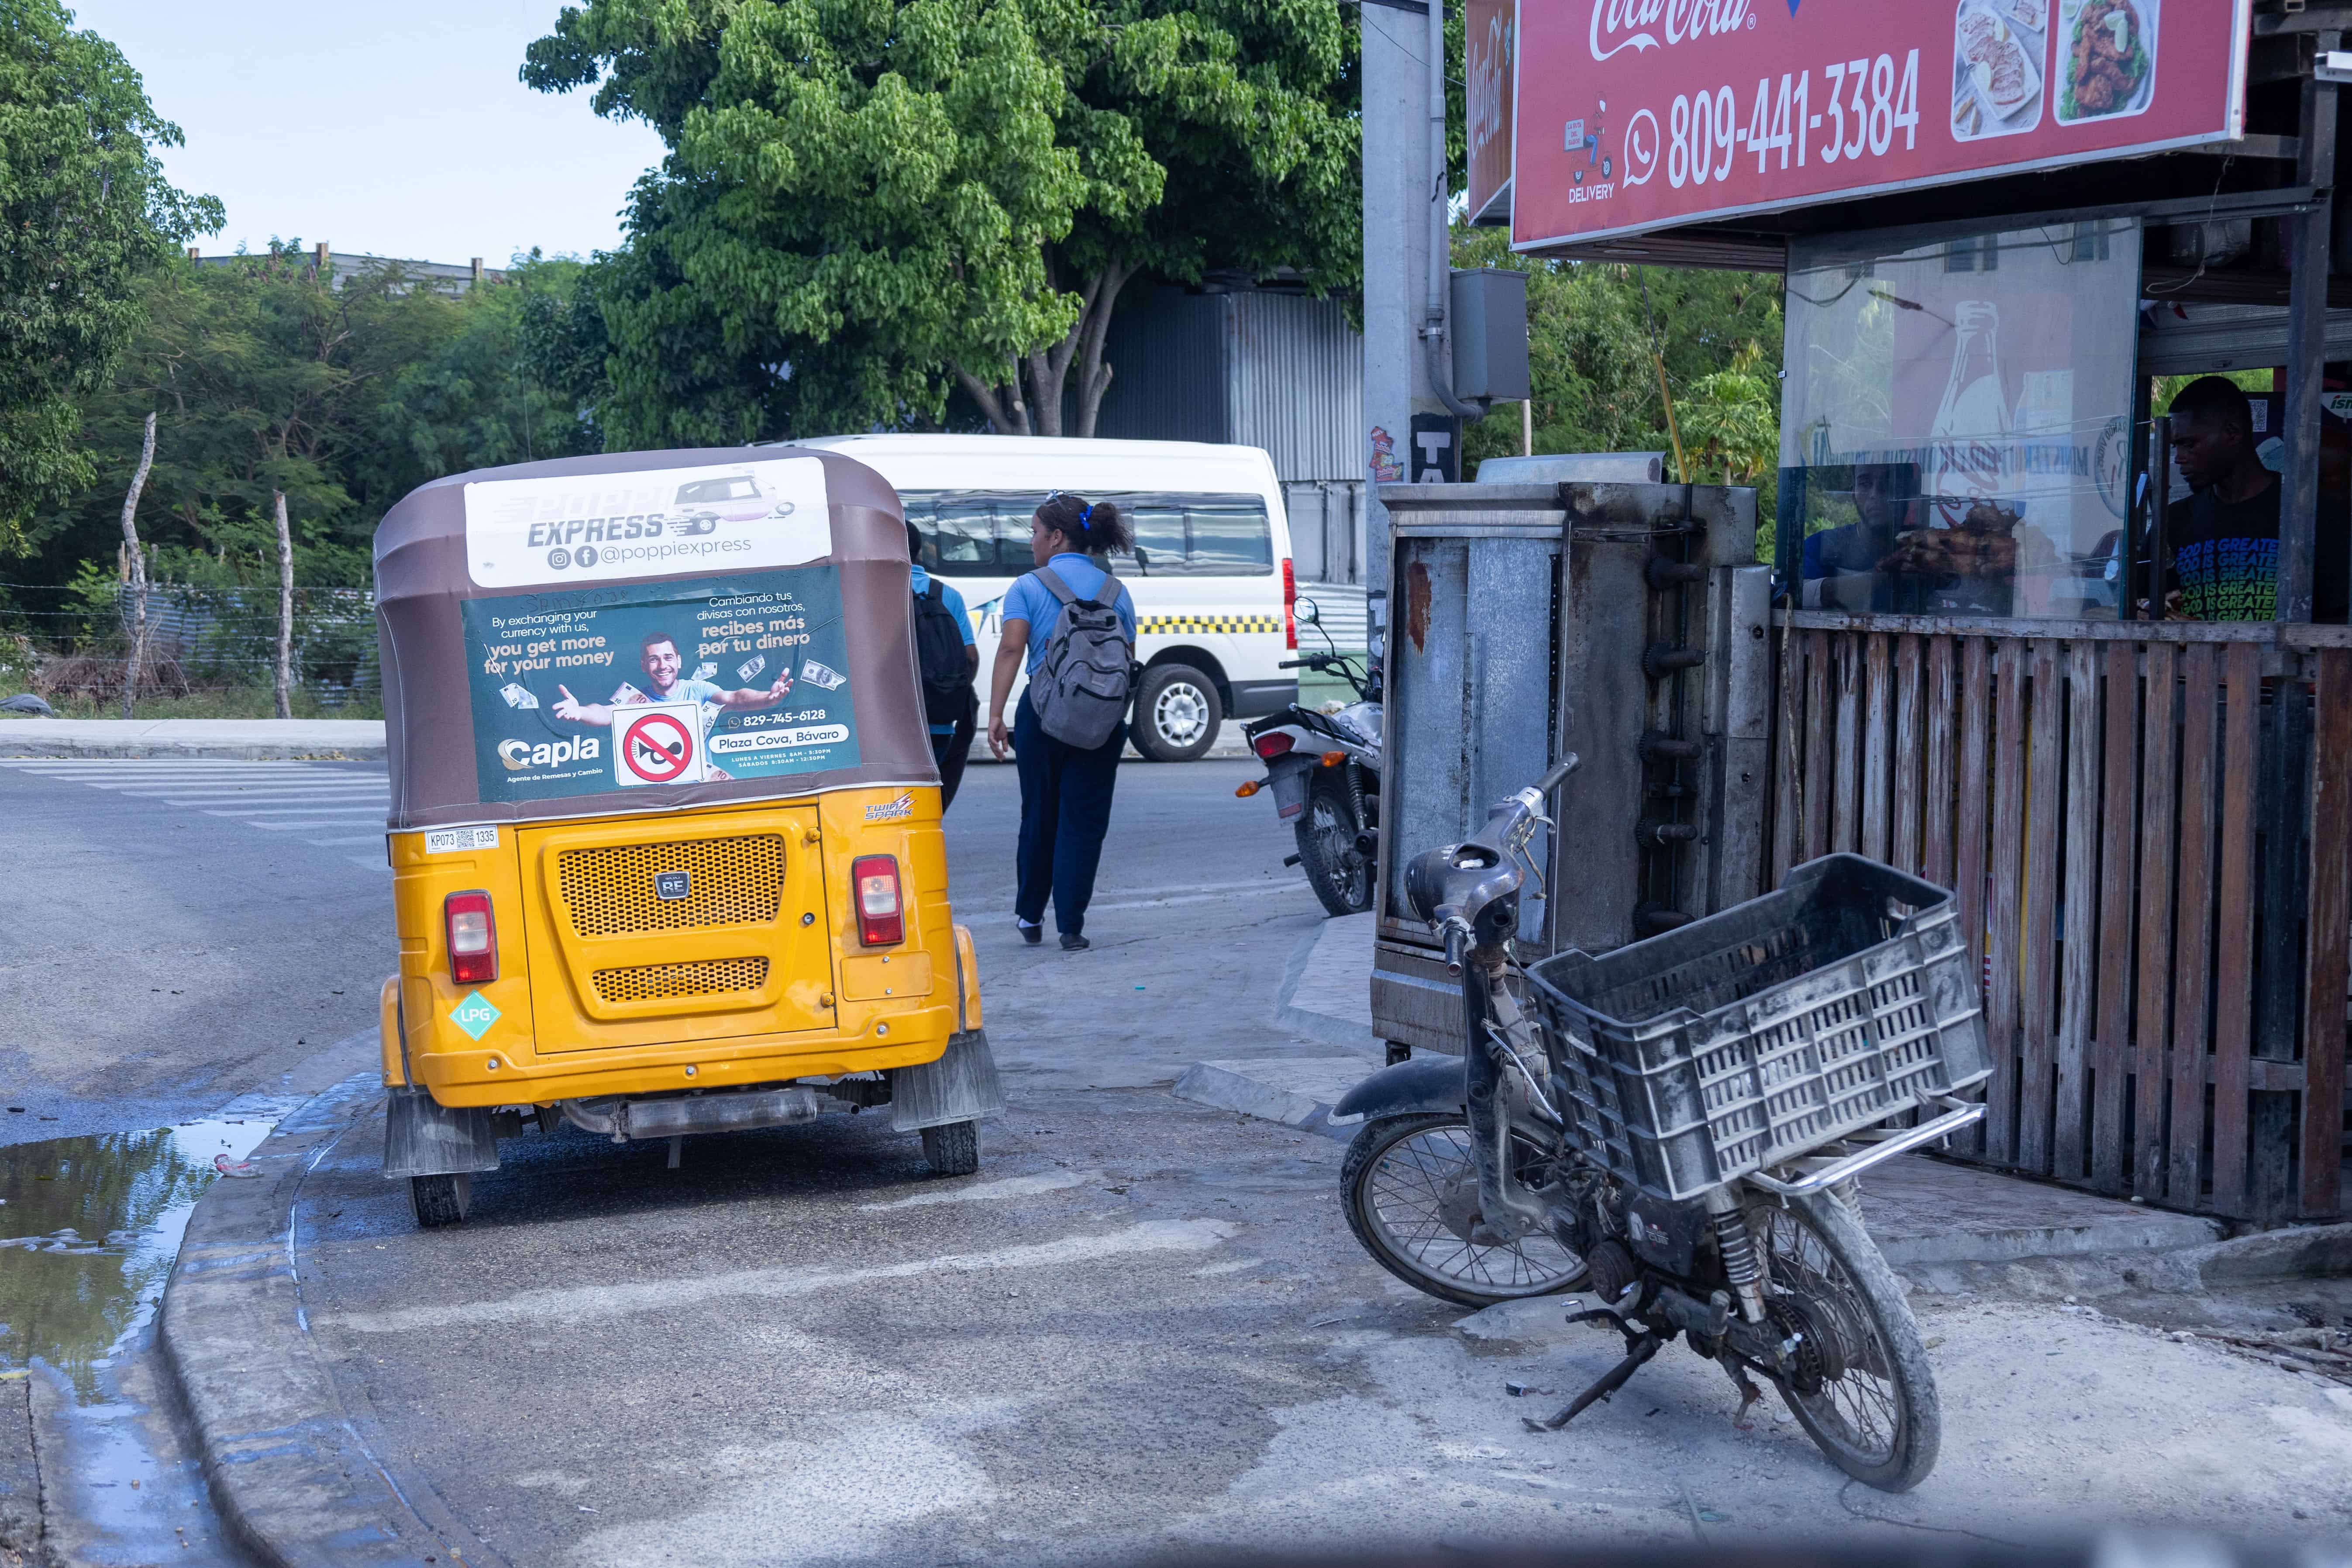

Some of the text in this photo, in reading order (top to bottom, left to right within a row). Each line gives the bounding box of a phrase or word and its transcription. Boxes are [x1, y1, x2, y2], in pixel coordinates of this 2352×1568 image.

[1668, 48, 1919, 188] 809-441-3384
[1569, 183, 1615, 203] DELIVERY
[527, 513, 664, 548] EXPRESS
[601, 538, 751, 564] @poppiexpress
[2204, 539, 2215, 553] IS
[2218, 538, 2280, 552] GREATE
[2203, 554, 2214, 568] IS
[2218, 552, 2278, 567] GREATE
[2203, 569, 2215, 583] IS
[2205, 583, 2217, 596] IS
[709, 592, 792, 607] Cambiando tus
[2207, 597, 2217, 610] IS
[492, 610, 597, 629] By exchanging your
[697, 603, 806, 620] divisas con nosotros,
[501, 623, 589, 638] currency with us,
[702, 615, 806, 638] recibes más
[490, 636, 606, 660] you get more
[698, 633, 810, 659] por tu dinero
[484, 651, 615, 675] for your money
[744, 709, 826, 727] 829-745-6128
[719, 730, 839, 749] Plaza Cova, Bávaro
[503, 734, 600, 768] Capla
[865, 803, 899, 812] TWIN
[865, 809, 913, 820] SPARK
[431, 834, 455, 847] KP073
[476, 831, 495, 843] 1335
[662, 880, 684, 894] RE
[461, 1008, 490, 1022] LPG
